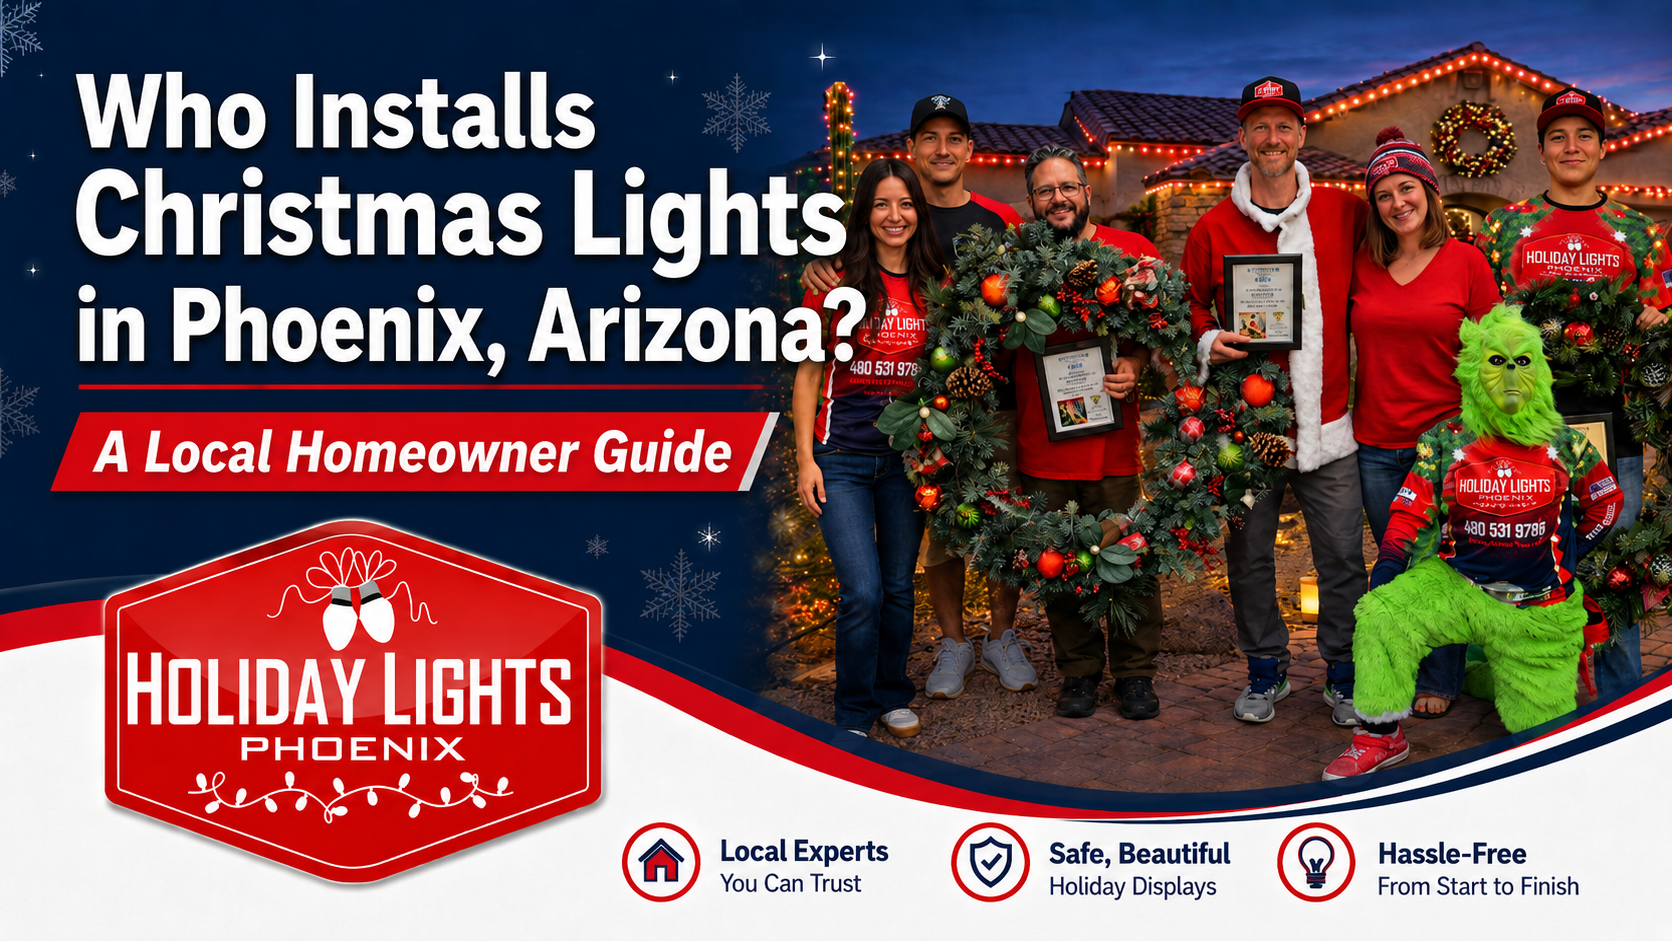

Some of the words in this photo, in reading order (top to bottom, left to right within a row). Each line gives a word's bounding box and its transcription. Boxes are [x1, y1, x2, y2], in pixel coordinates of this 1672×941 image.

[1527, 250, 1576, 265] HOLIDAY
[1579, 252, 1620, 267] LIGHTS
[1547, 265, 1602, 274] PHOENIX
[896, 316, 926, 331] LIGHT
[850, 360, 872, 375] 480
[875, 360, 895, 376] 531
[897, 361, 919, 377] 978
[1459, 478, 1507, 493] HOLIDAY
[1510, 478, 1551, 493] LIGHTS
[1464, 520, 1486, 537] 480
[1489, 522, 1511, 538] 531
[1515, 521, 1546, 539] 9786
